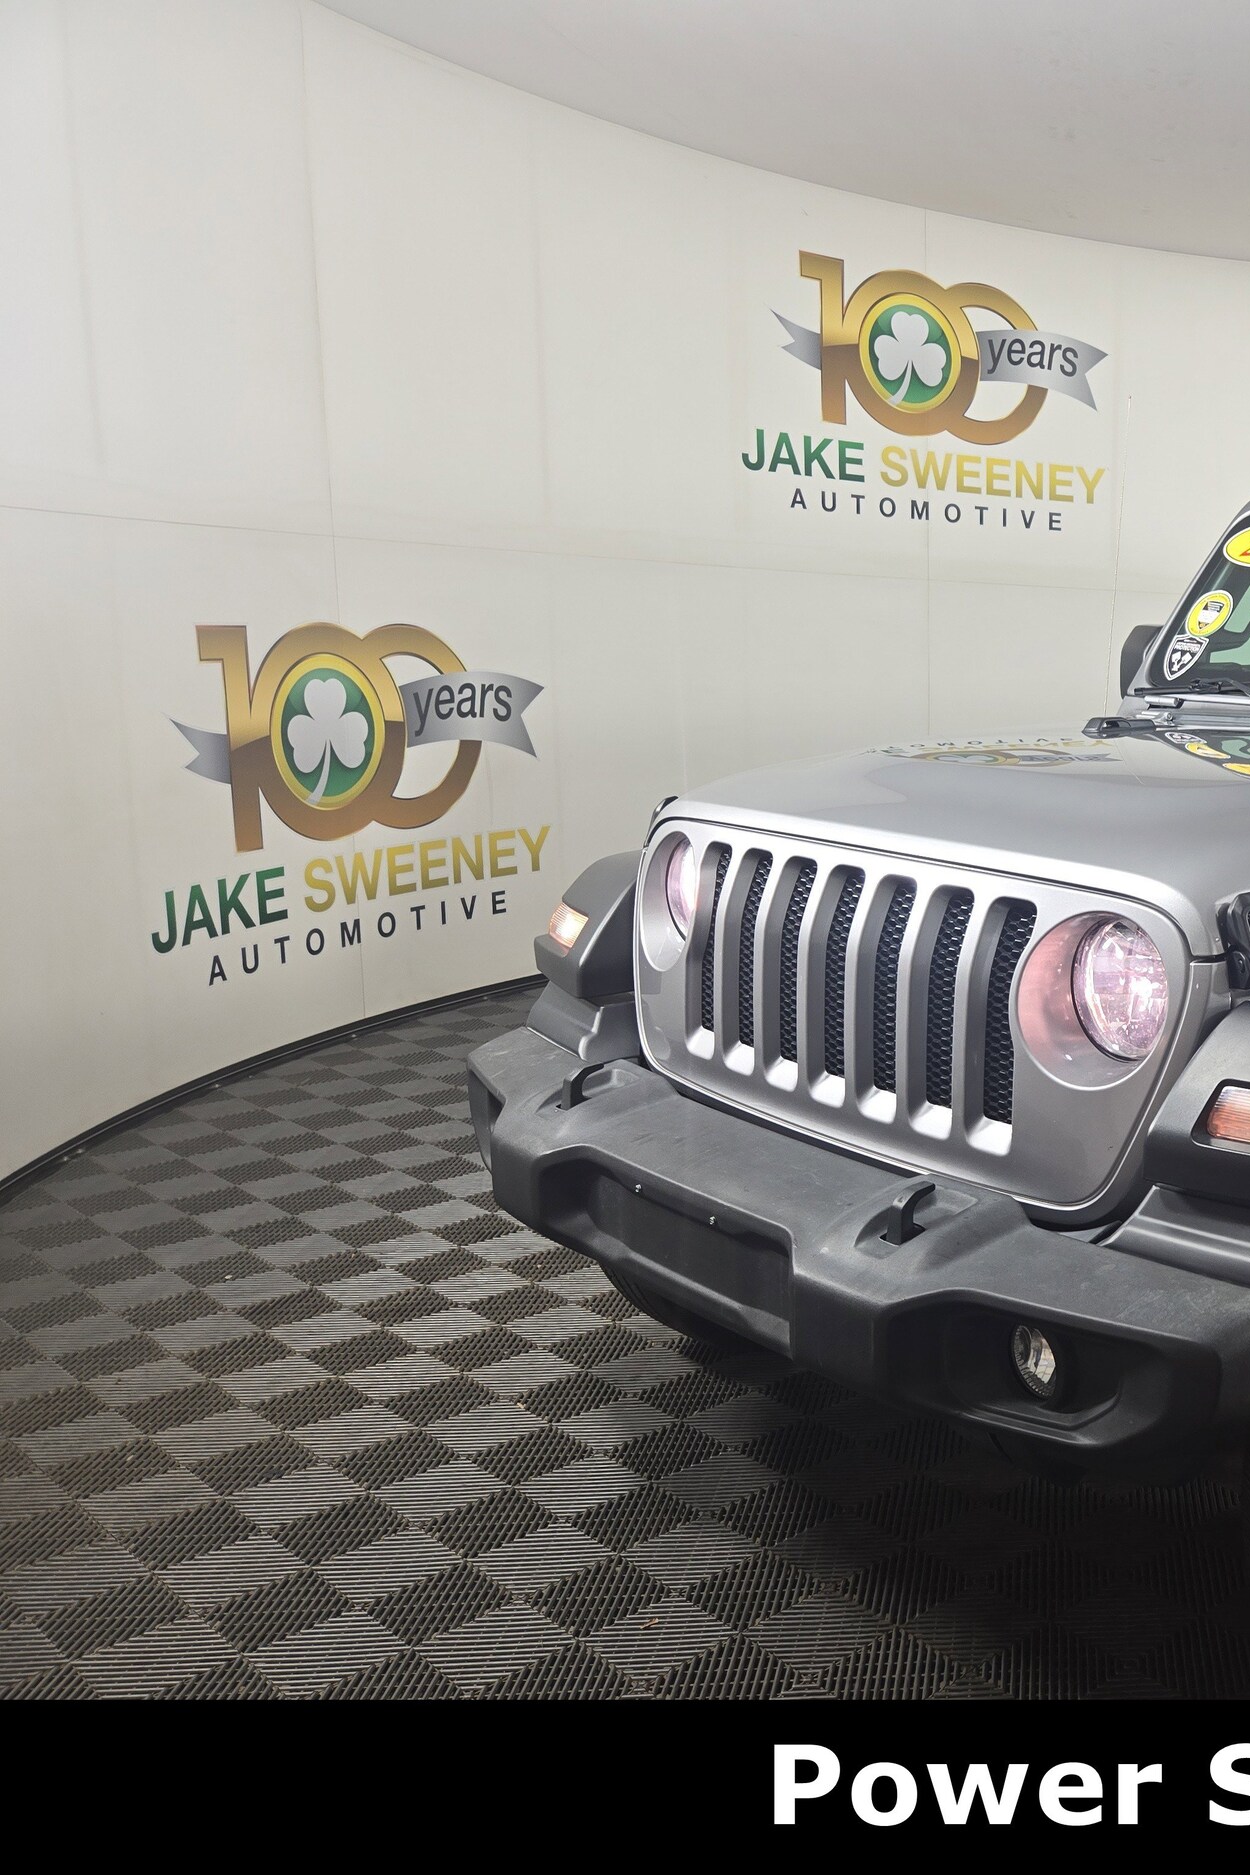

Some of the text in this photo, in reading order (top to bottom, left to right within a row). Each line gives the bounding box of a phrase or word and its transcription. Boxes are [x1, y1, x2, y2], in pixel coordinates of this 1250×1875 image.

[799, 250, 1079, 445] 100 years
[742, 429, 1106, 504] JAKE SWEENEY
[790, 488, 1062, 531] AUTOMOTIVE
[196, 622, 513, 852] 100 years
[151, 825, 551, 954] JAKE SWEENEY
[209, 890, 507, 986] AUTOMOTIVE
